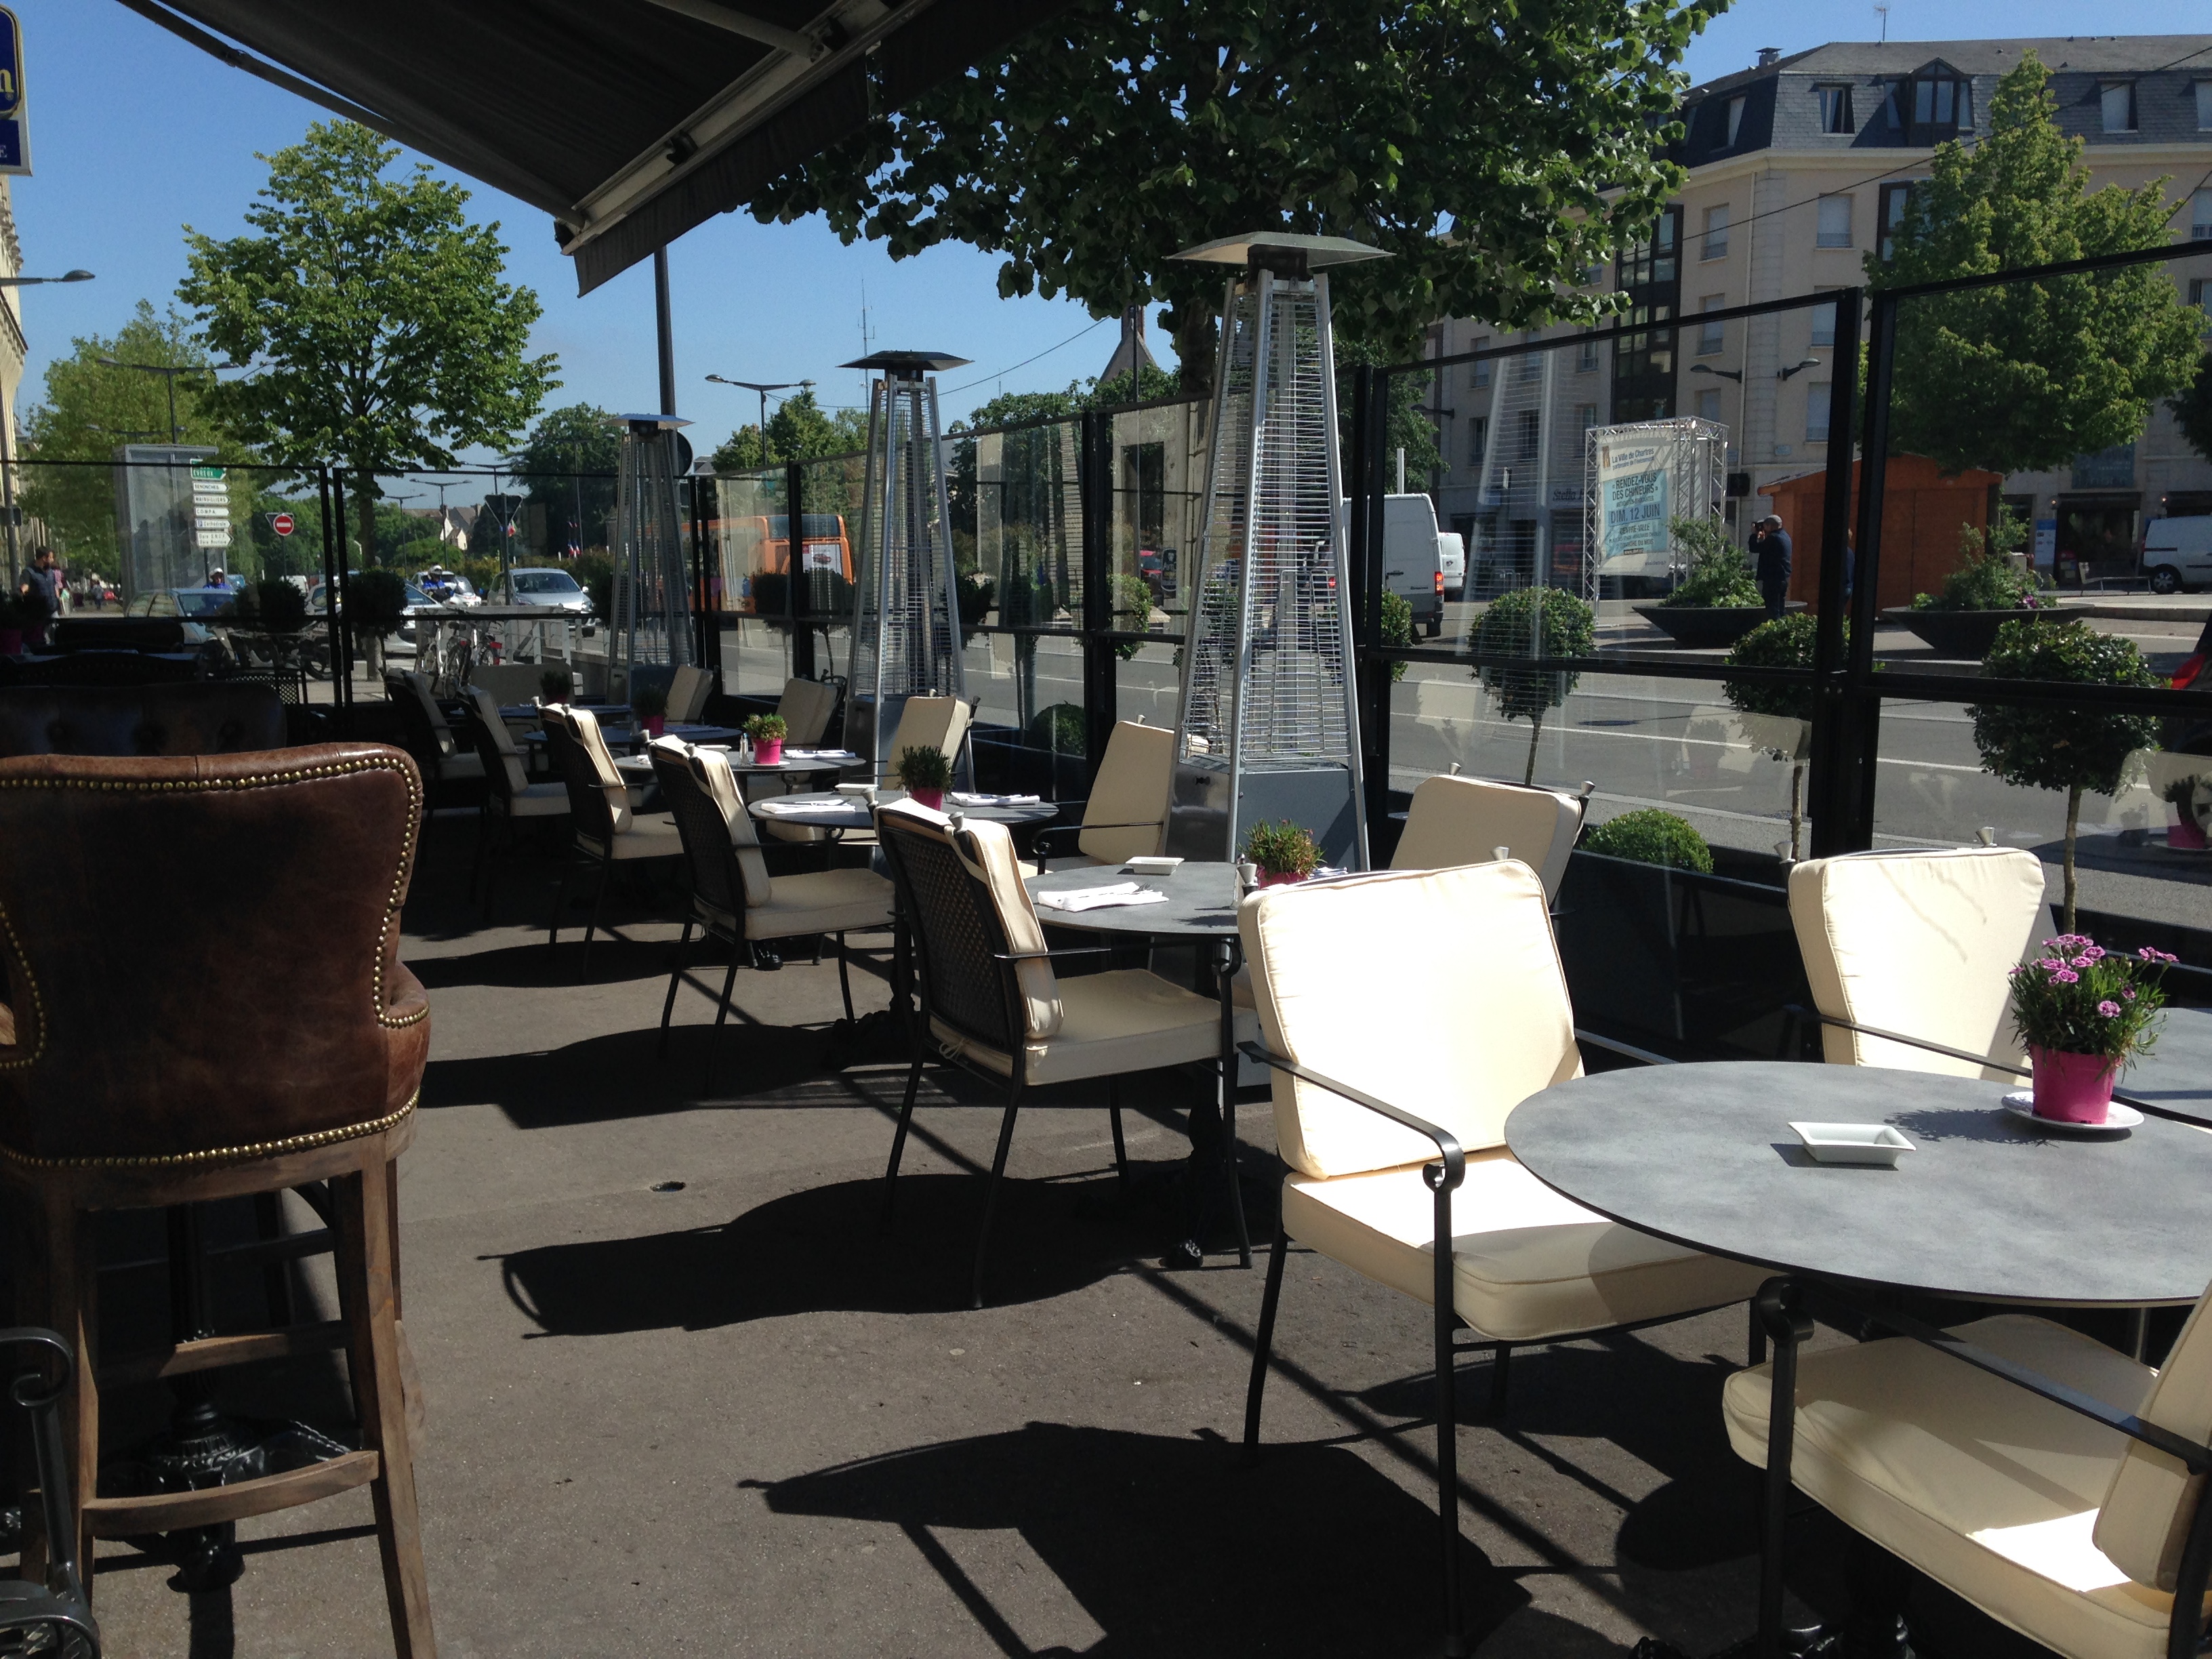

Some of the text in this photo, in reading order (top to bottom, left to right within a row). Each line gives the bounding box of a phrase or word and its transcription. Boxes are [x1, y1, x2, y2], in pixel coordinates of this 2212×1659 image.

[1618, 453, 1628, 462] Ville
[1635, 448, 1654, 458] Chartres
[1616, 472, 1657, 489] RENDEZ-VOUS
[1612, 489, 1624, 501] DES
[1624, 483, 1654, 498] CHINEURS
[1611, 504, 1660, 524] DIM. 12 JUIN
